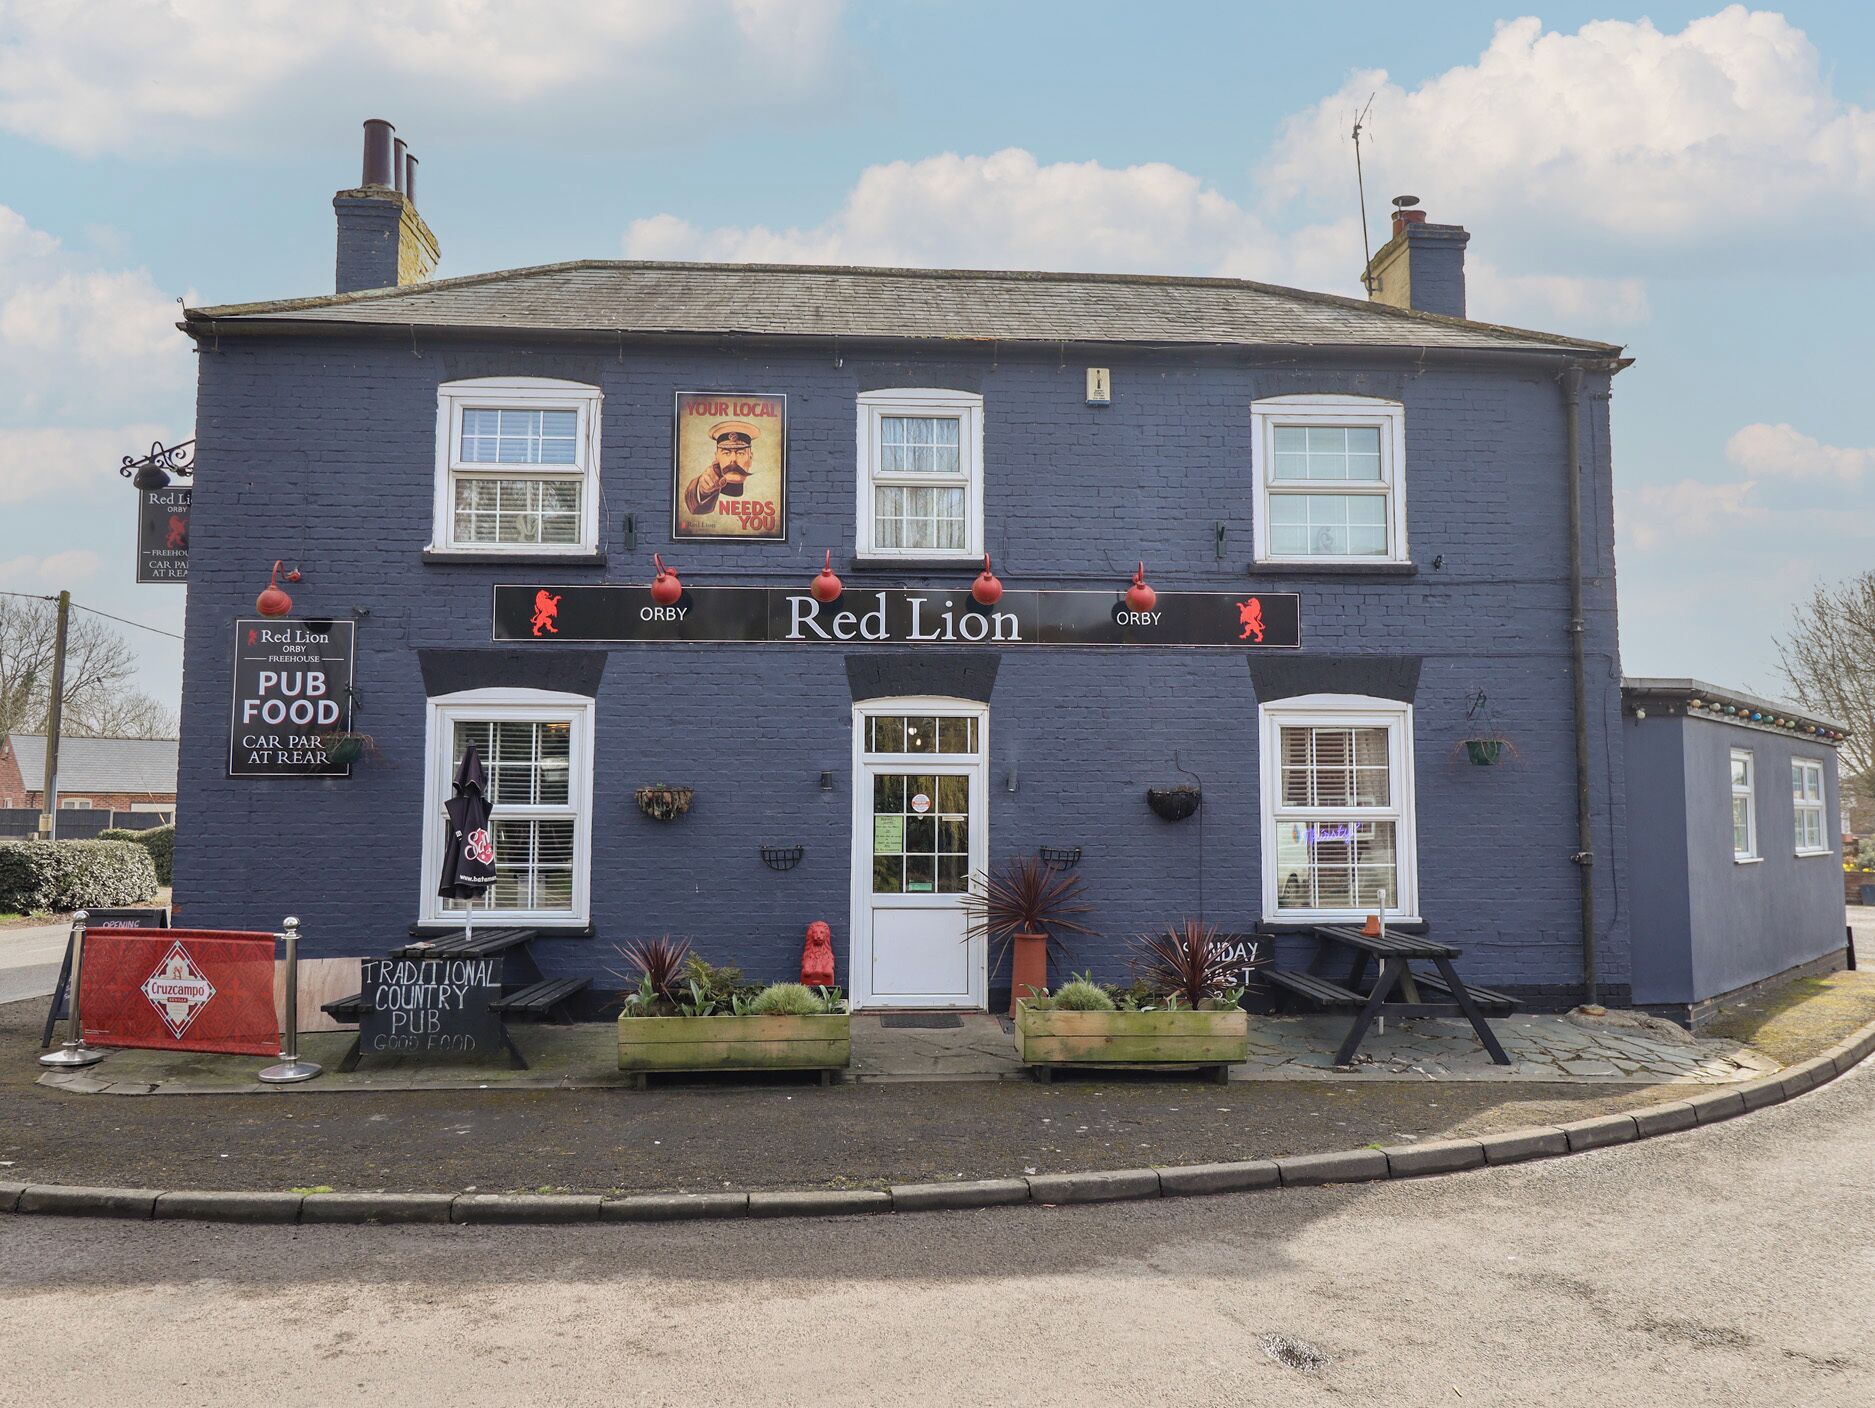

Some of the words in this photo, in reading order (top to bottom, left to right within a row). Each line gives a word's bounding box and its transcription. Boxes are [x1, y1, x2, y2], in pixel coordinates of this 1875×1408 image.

[687, 401, 729, 417] YOUR
[733, 402, 778, 418] LOCAL
[148, 492, 174, 505] Red
[178, 493, 192, 505] Li
[719, 500, 776, 516] NEEDS
[738, 516, 776, 531] YOU
[148, 560, 171, 569] CAR
[152, 569, 166, 577] AT
[640, 607, 688, 622] ORBY
[785, 592, 890, 640] Red
[905, 597, 1022, 642] Lion
[1116, 611, 1162, 626] ORBY
[261, 629, 291, 643] Red
[295, 630, 329, 643] Lion
[268, 655, 320, 663] FREEHOUSE
[258, 671, 327, 697] PUB
[243, 699, 340, 726] FOOD
[242, 735, 283, 749] CAR
[288, 735, 326, 749] PAR
[248, 751, 273, 764] AT
[277, 751, 331, 764] REAR
[361, 960, 502, 987] TRADITIONAL
[151, 982, 205, 998] Cruzcampo
[375, 985, 469, 1011] COUNTRY
[391, 1009, 441, 1035] PUB
[374, 1033, 419, 1051] GOOD
[427, 1034, 476, 1051] FOOD
